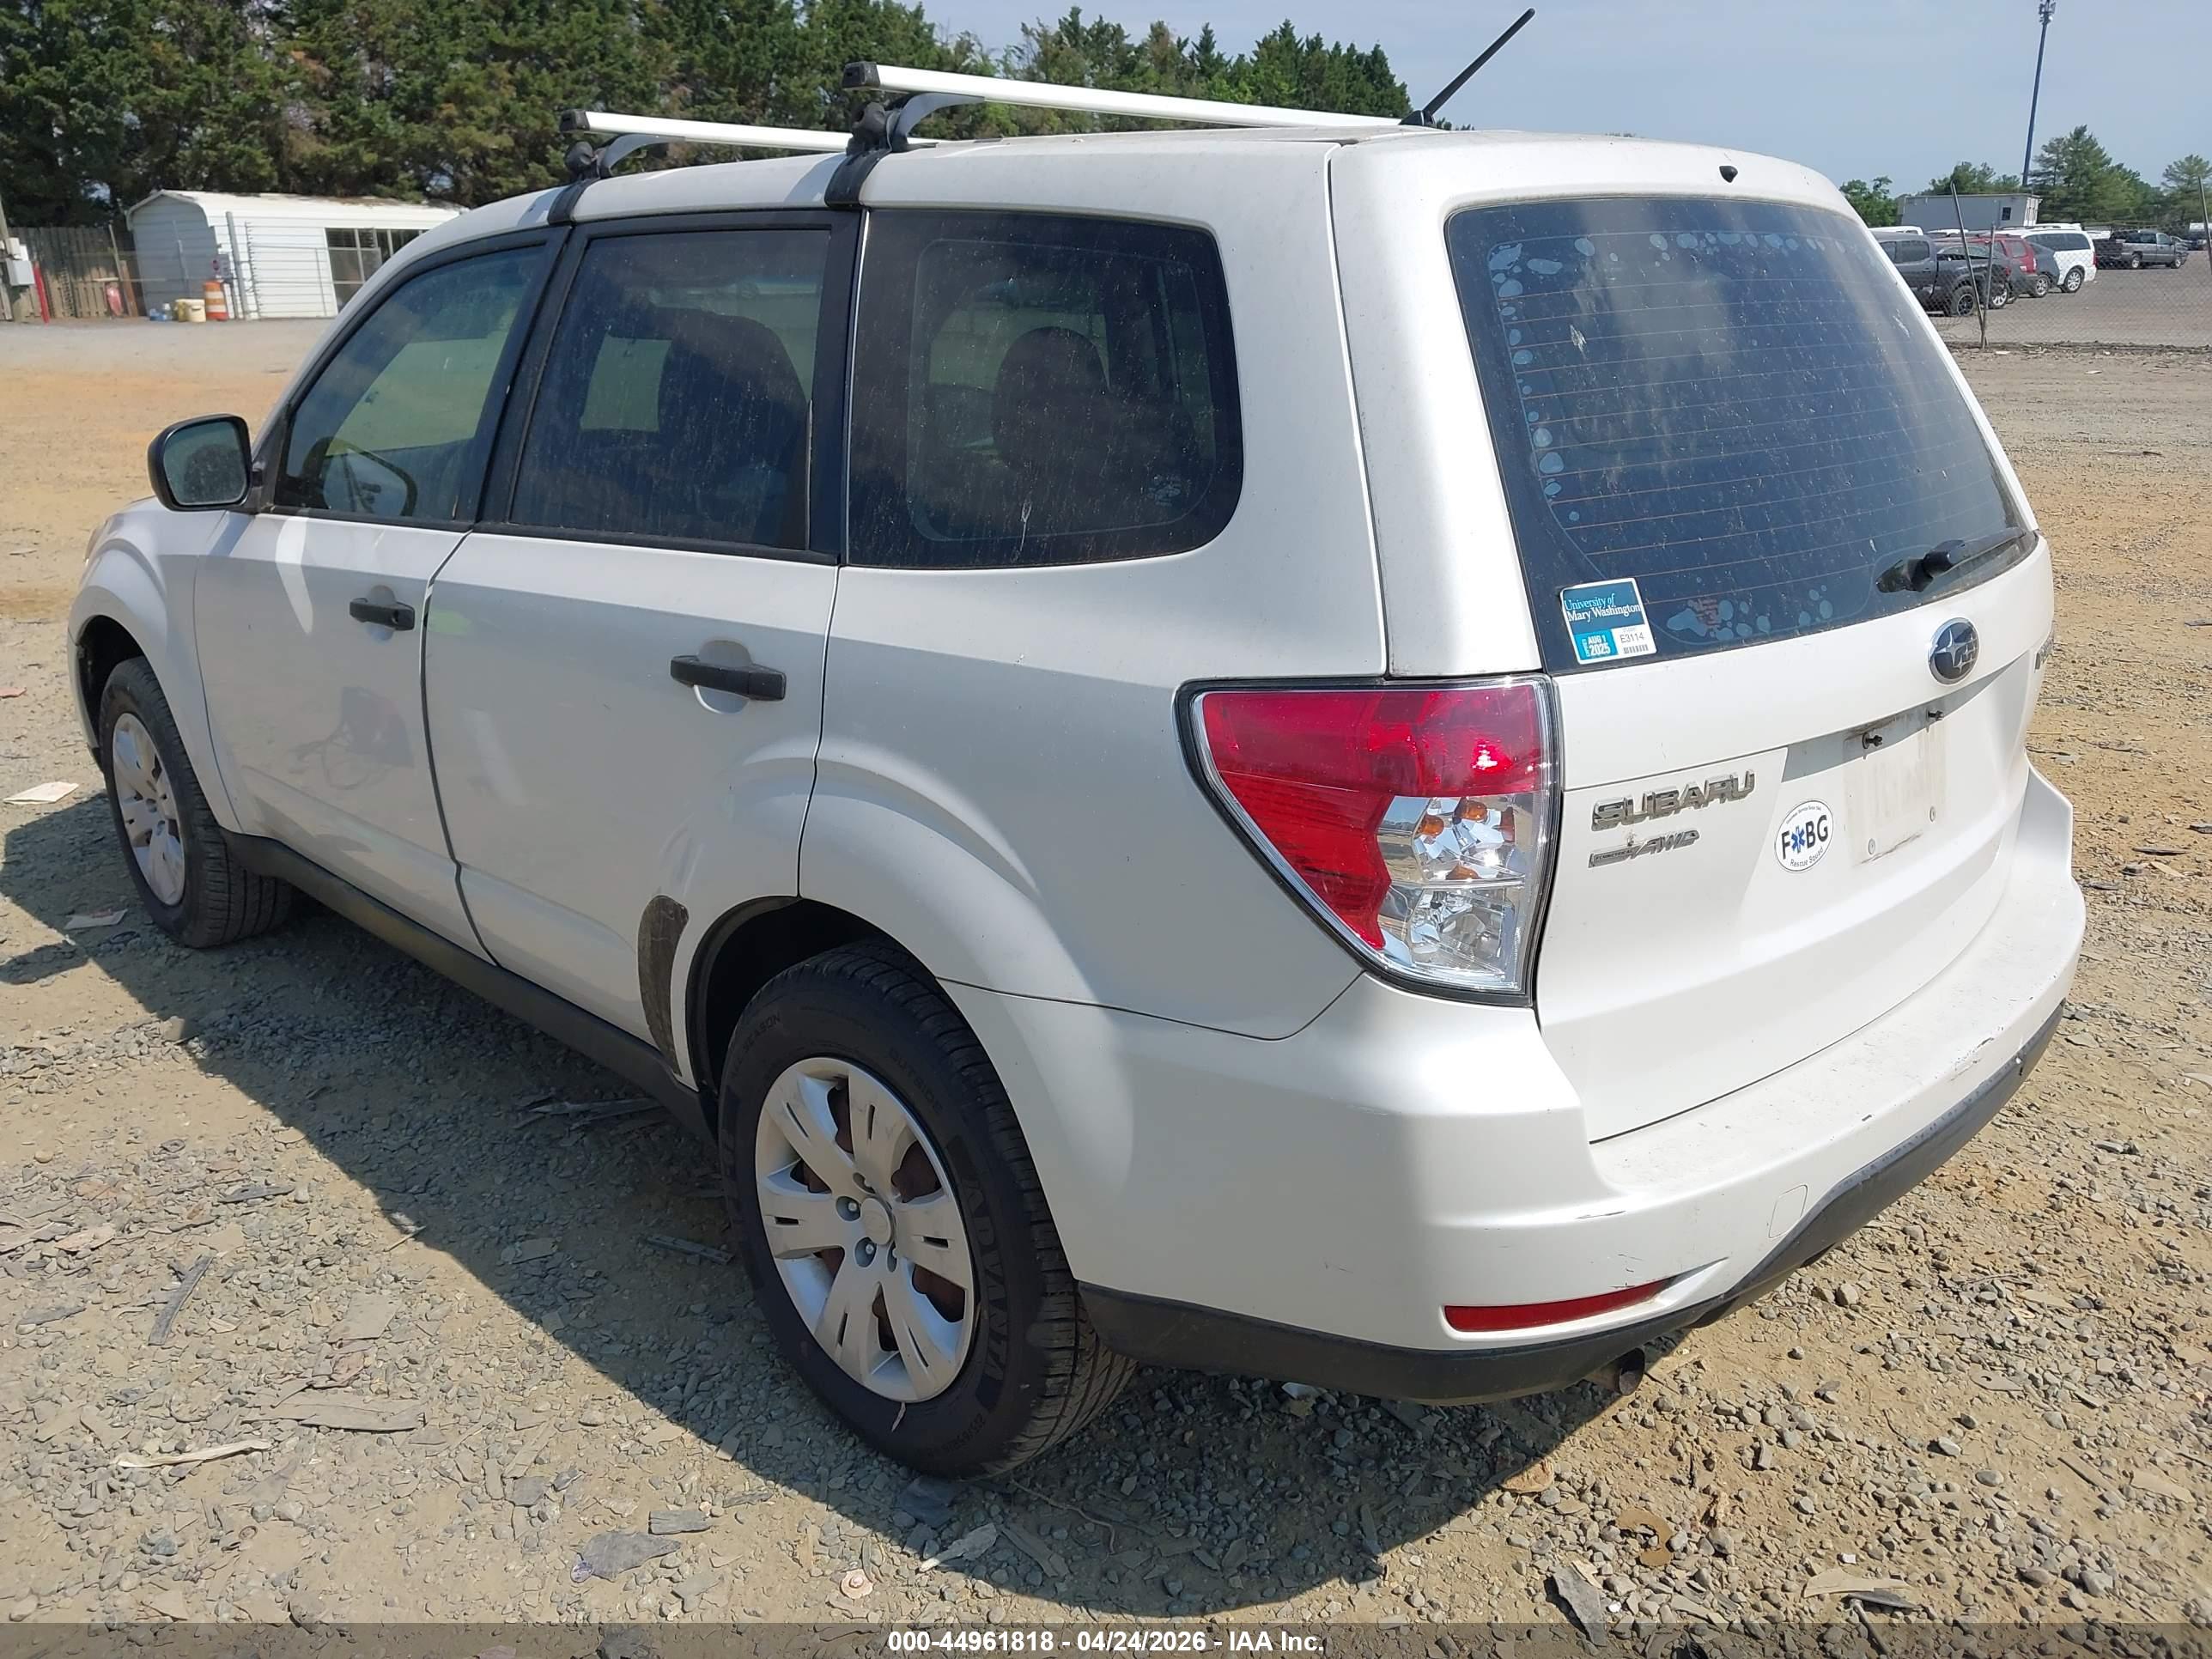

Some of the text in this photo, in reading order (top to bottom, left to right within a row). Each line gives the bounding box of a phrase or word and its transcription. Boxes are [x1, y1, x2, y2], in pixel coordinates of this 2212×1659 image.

[1564, 592, 1615, 611] University of
[1566, 604, 1641, 623] Mary Washington
[1588, 635, 1601, 643] AUG
[1620, 632, 1644, 643] E3114
[1589, 642, 1611, 656] 2025
[1591, 769, 1756, 831] SUBARU
[1633, 829, 1700, 859] AWD
[962, 1178, 1009, 1381] ADVANTA
